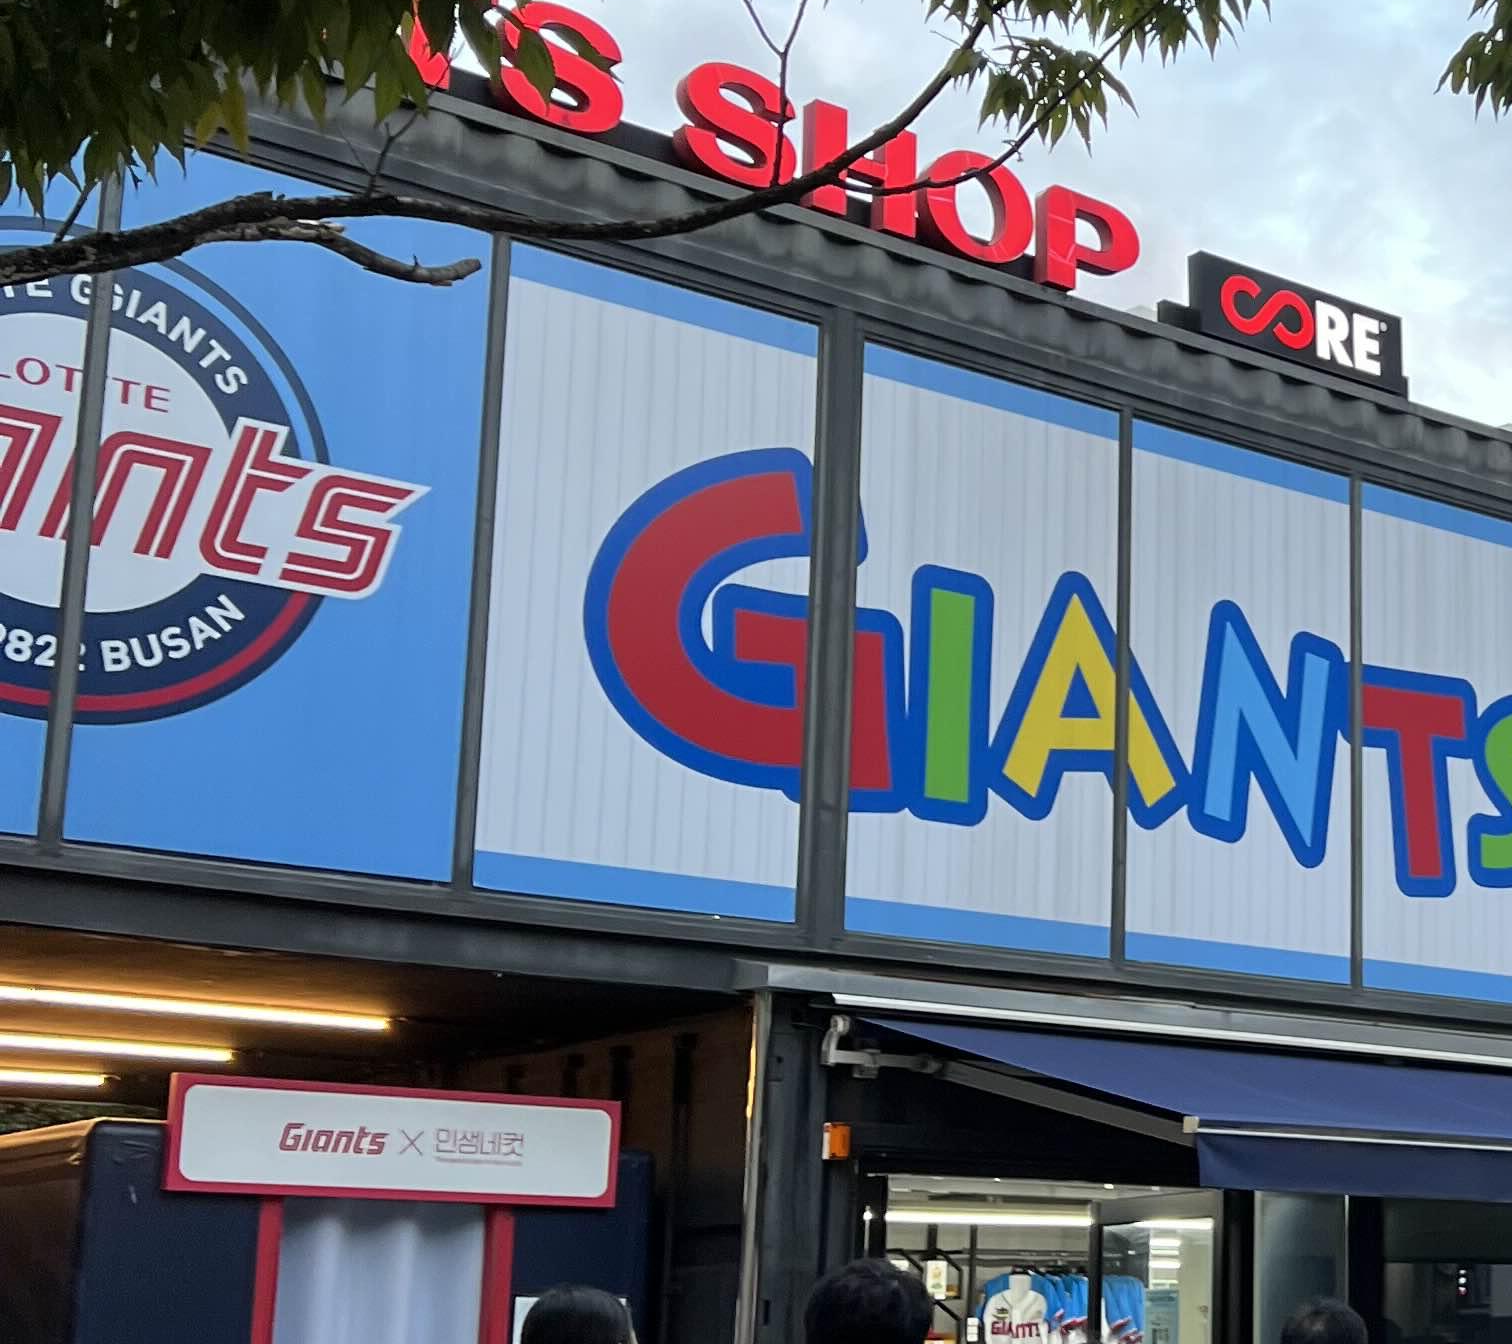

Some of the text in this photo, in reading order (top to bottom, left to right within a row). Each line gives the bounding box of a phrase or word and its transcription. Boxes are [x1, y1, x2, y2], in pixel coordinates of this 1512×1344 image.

[673, 62, 1140, 291] SHOP
[0, 357, 170, 414] OTTE
[100, 594, 246, 673] BUSAN
[279, 1122, 390, 1155] Giants
